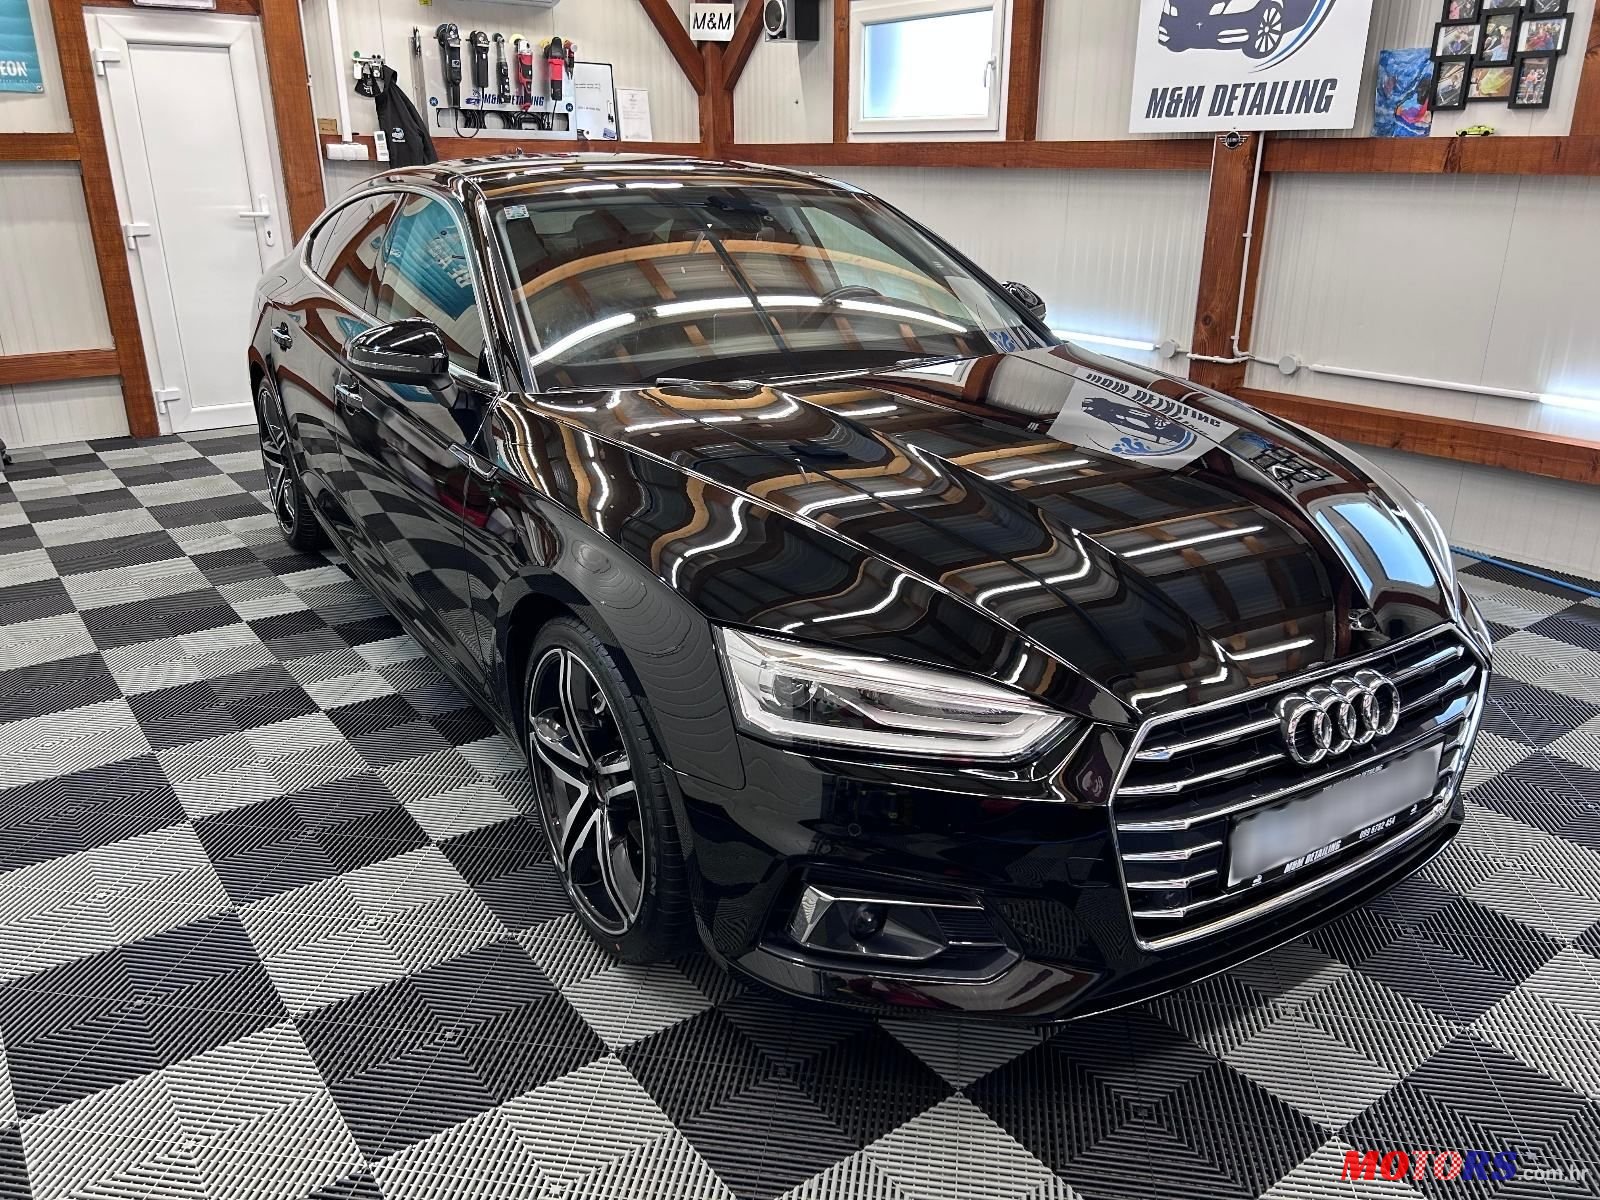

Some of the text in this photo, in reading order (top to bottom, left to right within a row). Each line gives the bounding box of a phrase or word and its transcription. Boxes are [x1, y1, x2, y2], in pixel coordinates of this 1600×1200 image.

[693, 12, 732, 30] M&M
[1145, 78, 1338, 119] M&M DETAILING
[1304, 840, 1342, 865] DETAILING
